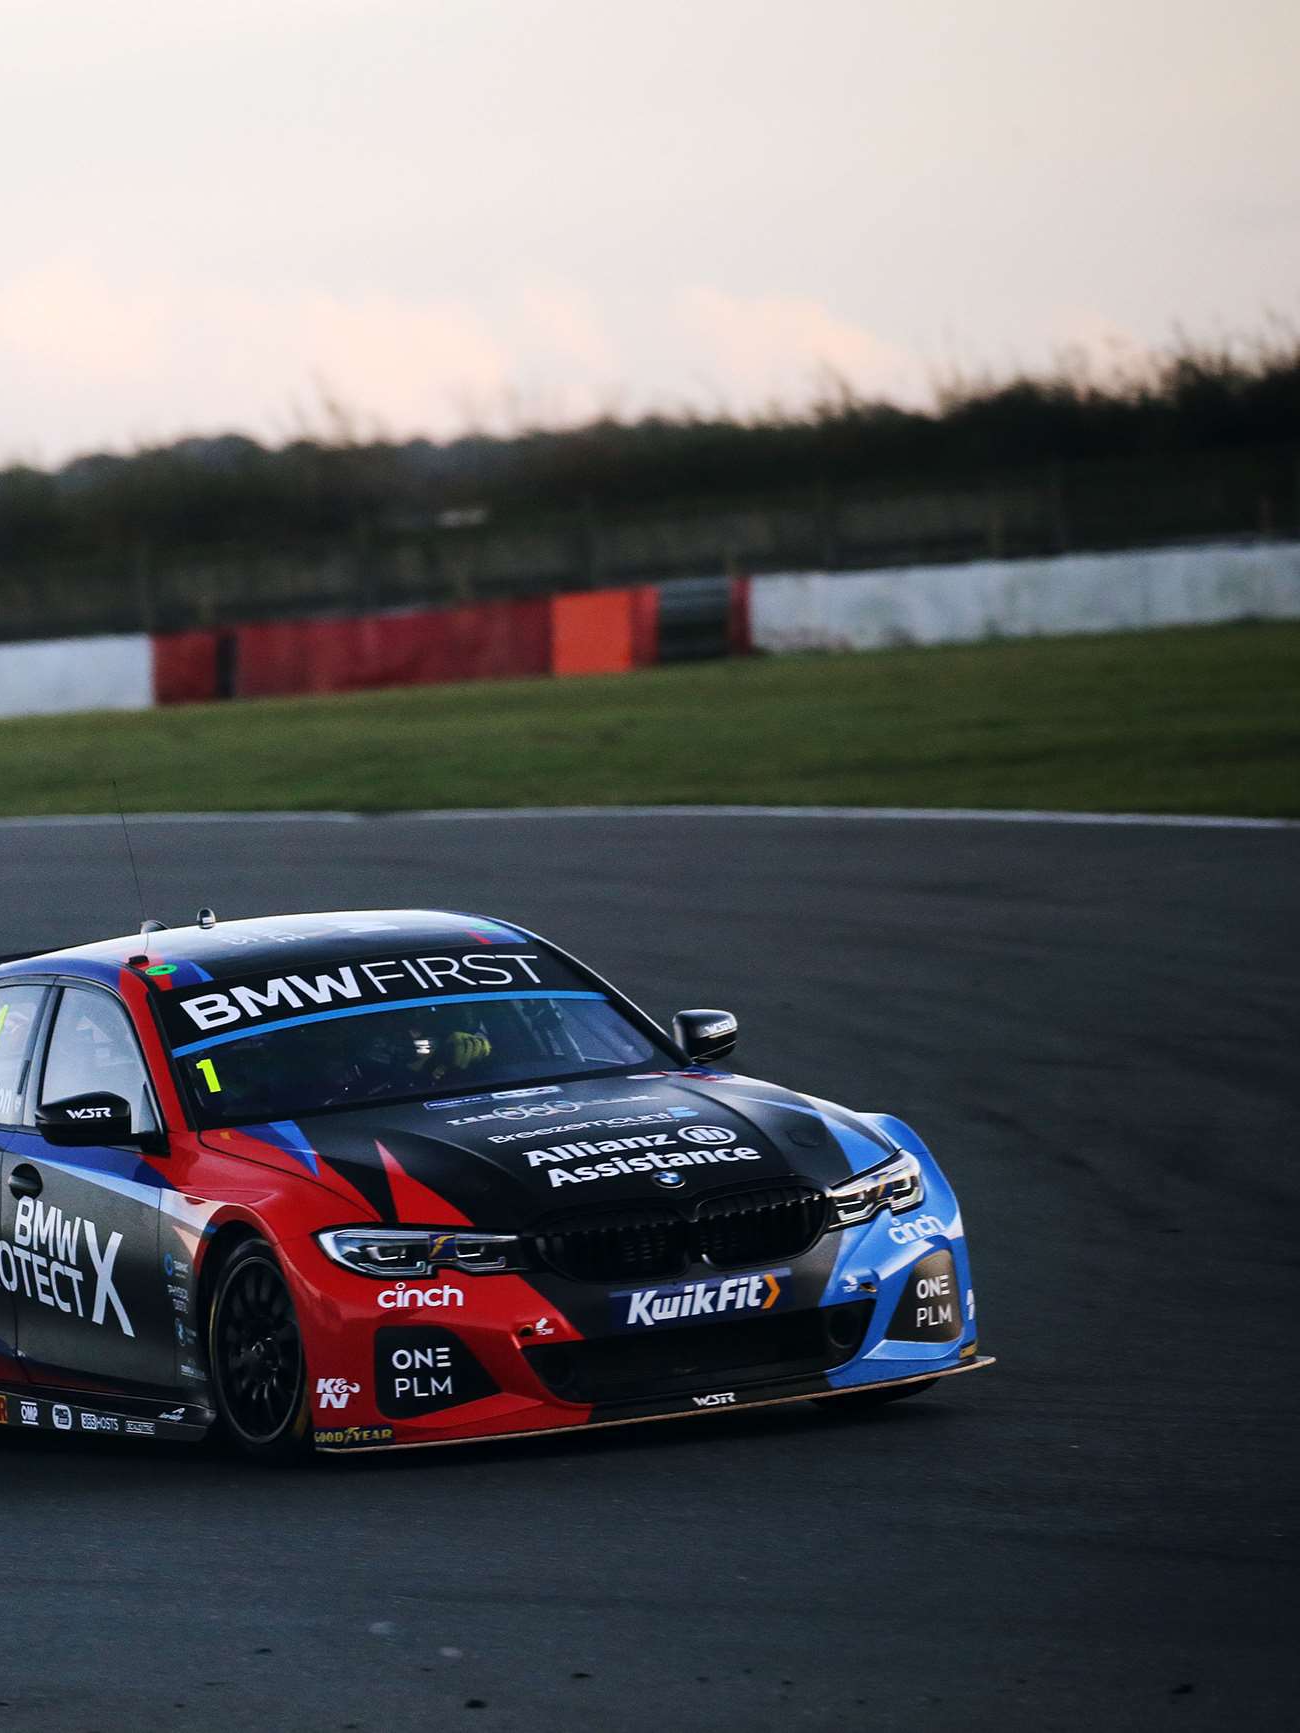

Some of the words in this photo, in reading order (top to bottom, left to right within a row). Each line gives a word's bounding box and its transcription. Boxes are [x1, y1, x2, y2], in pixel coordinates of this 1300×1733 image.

[196, 1058, 222, 1093] 1
[65, 1106, 112, 1119] WSR
[522, 1133, 678, 1168] Allianz
[547, 1146, 762, 1188] Assistance
[14, 1196, 82, 1266] BMW
[888, 1214, 948, 1245] cinch
[83, 1219, 136, 1338] X
[916, 1274, 950, 1299] ONE
[377, 1282, 464, 1308] cinch
[916, 1303, 952, 1327] PLM
[392, 1347, 452, 1370] ONE
[395, 1376, 453, 1398] PLM
[692, 1392, 736, 1406] WSR
